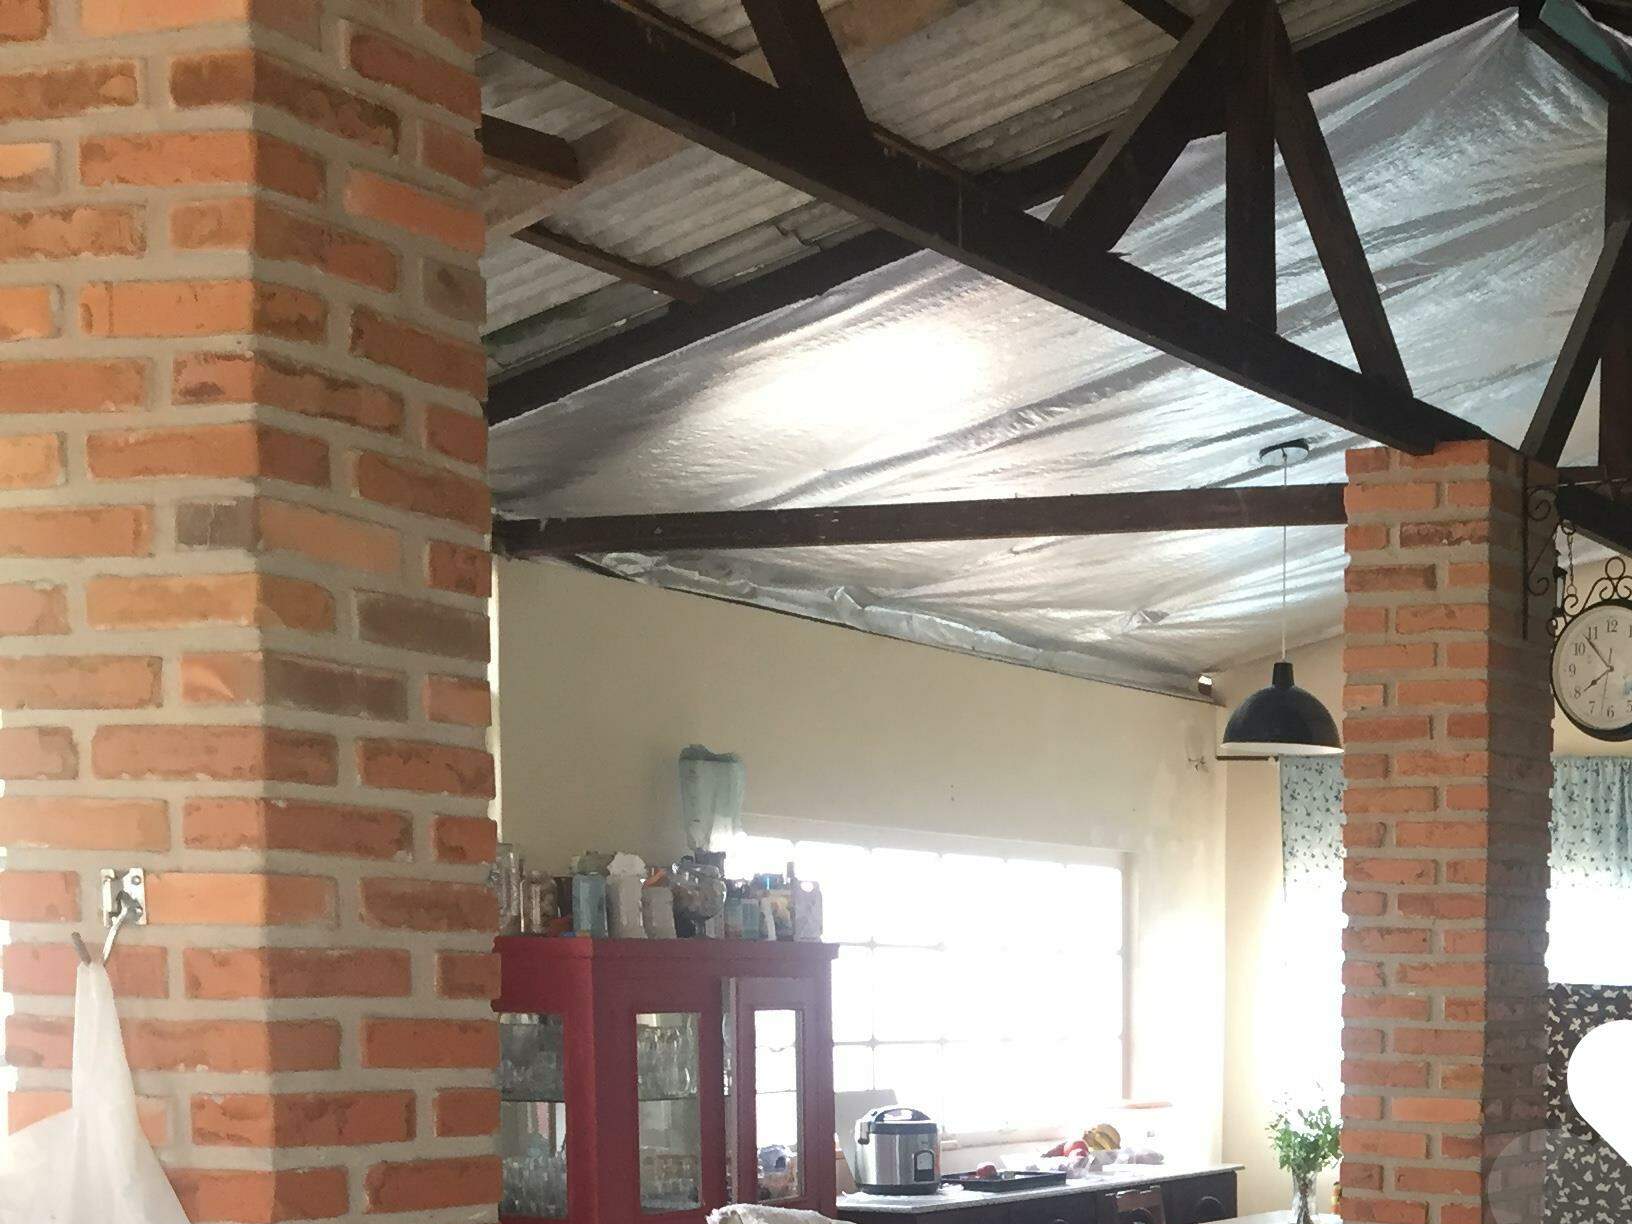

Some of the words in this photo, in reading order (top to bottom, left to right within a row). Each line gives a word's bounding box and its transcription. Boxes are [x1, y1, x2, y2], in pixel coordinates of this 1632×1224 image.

[1606, 619, 1618, 633] 12
[1587, 626, 1598, 640] 11
[1574, 642, 1586, 656] 10
[1568, 664, 1576, 676] 9
[1574, 687, 1582, 700] 8
[1588, 701, 1596, 714] 7
[1606, 705, 1615, 718] 6
